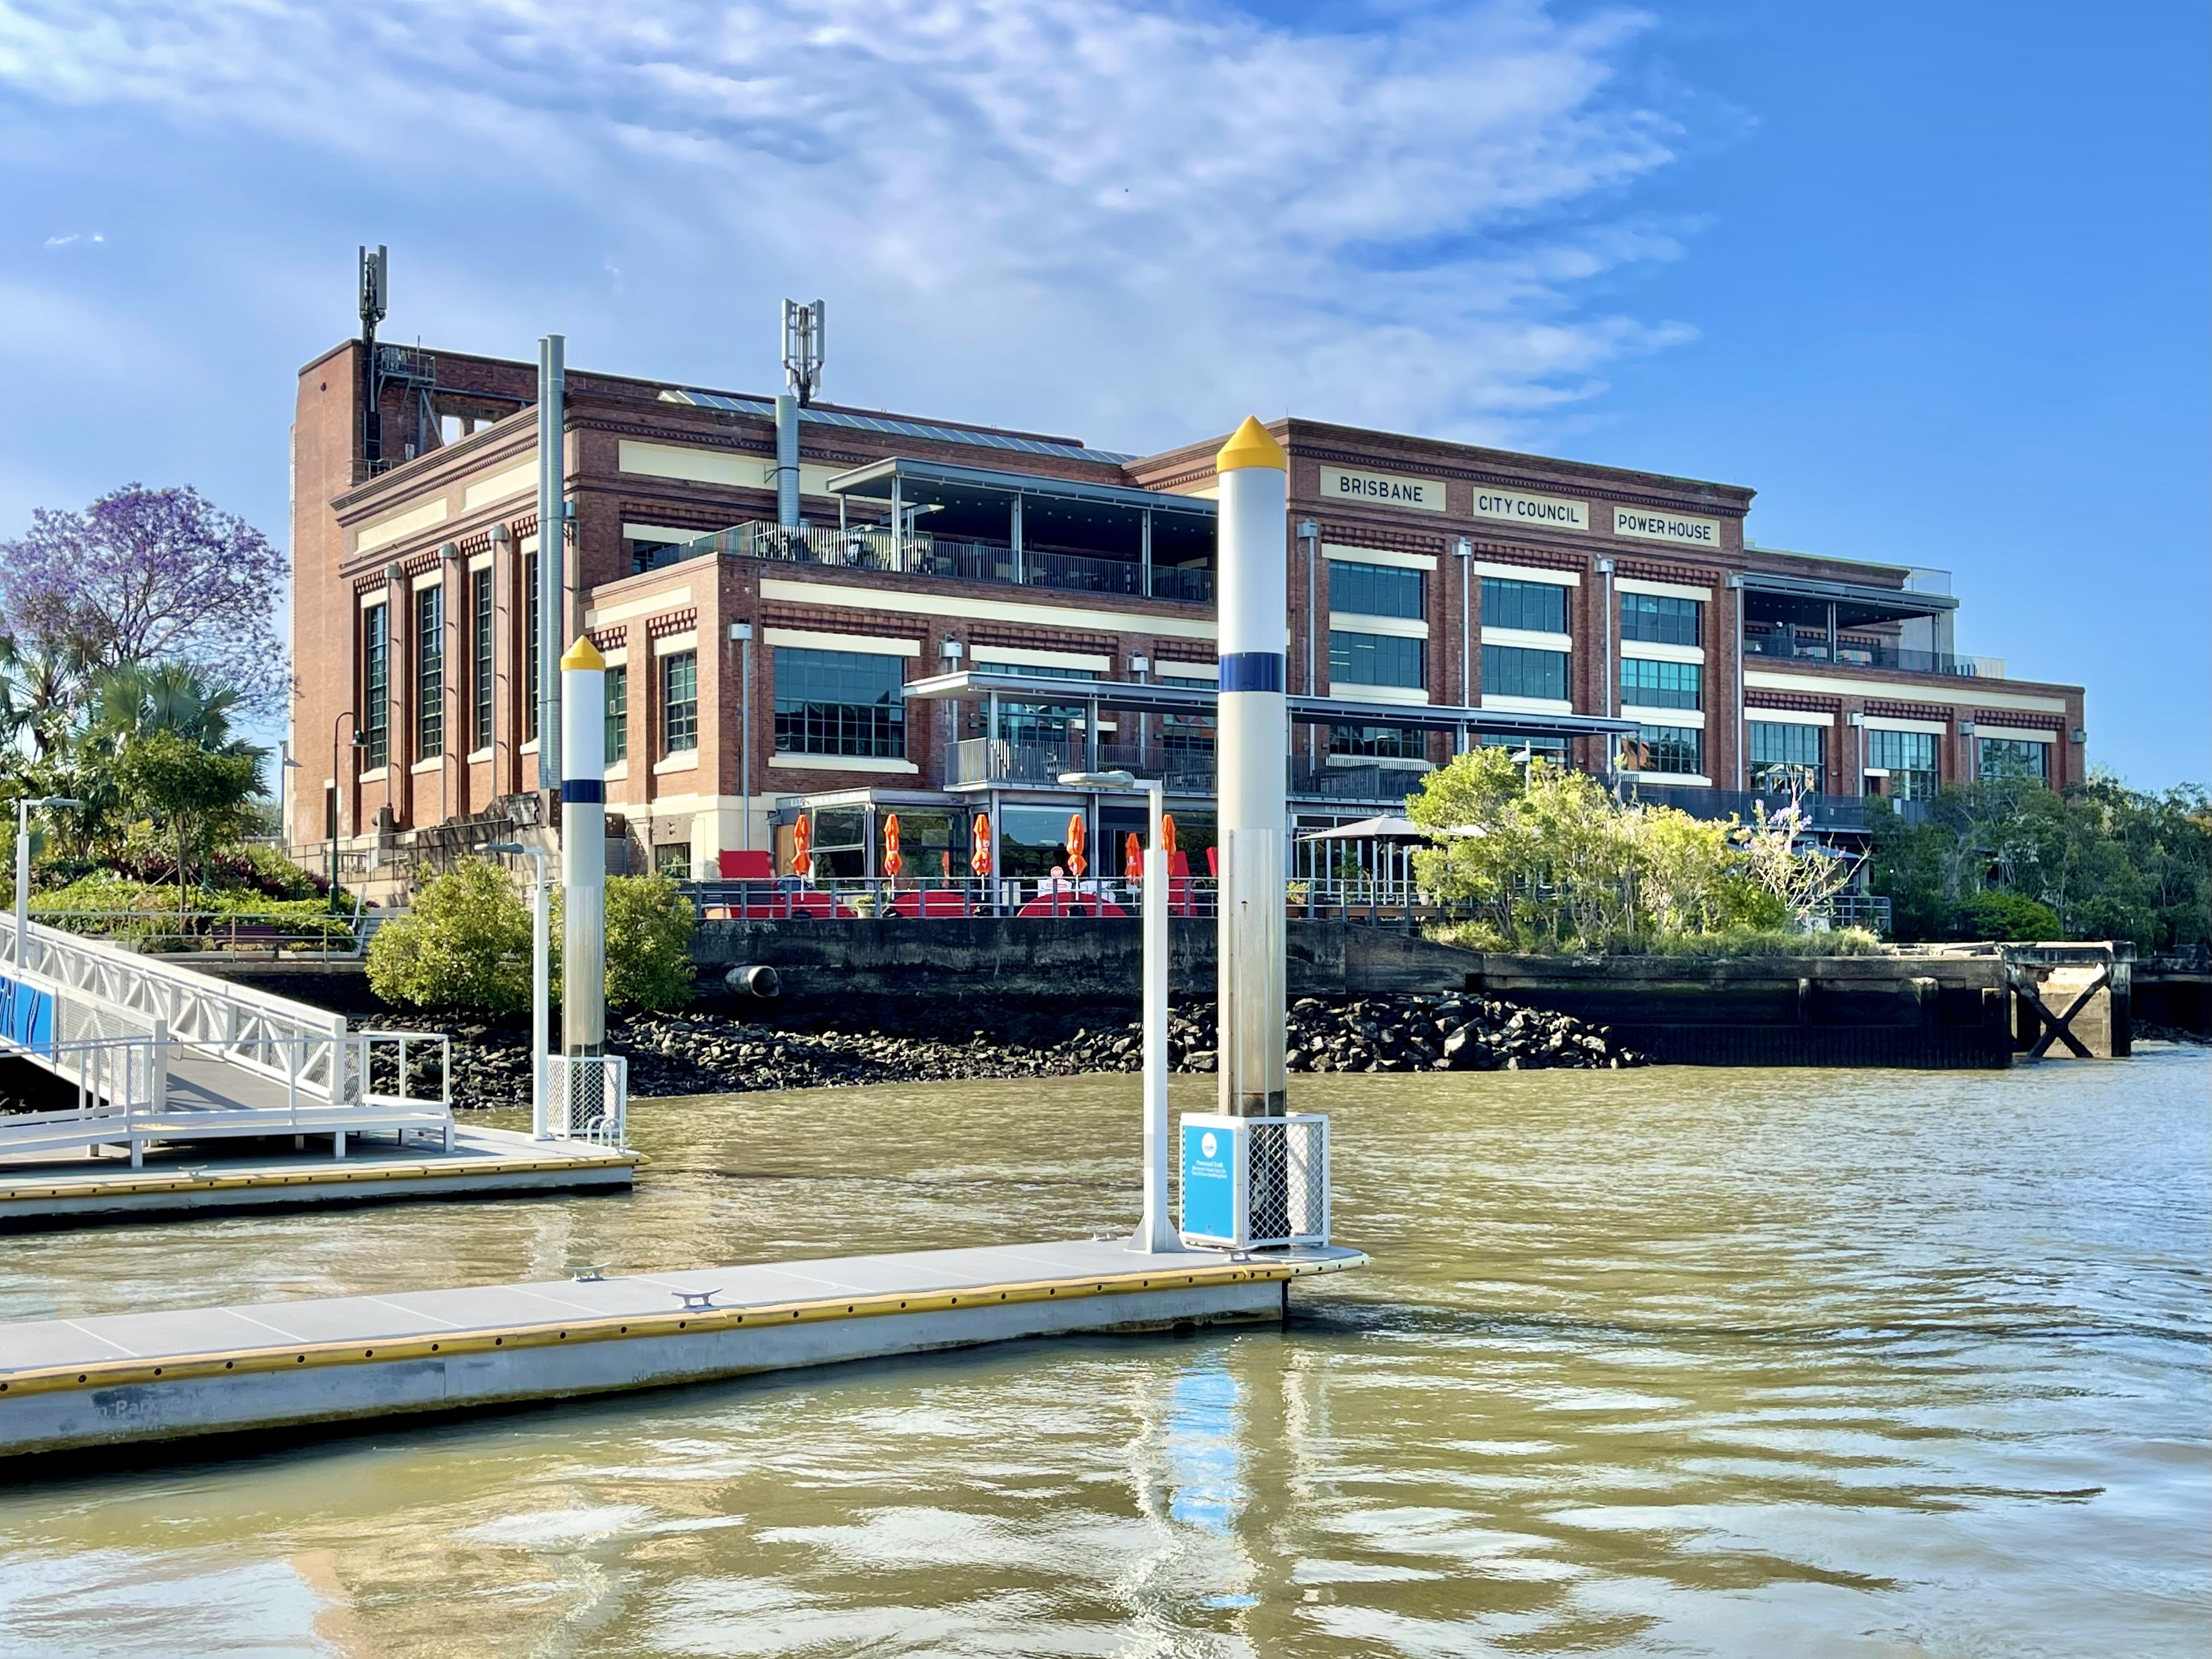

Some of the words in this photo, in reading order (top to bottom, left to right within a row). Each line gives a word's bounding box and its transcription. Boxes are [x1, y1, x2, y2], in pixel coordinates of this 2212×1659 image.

[1340, 476, 1423, 502] BRISBANE
[1479, 495, 1513, 514] CITY
[1518, 501, 1579, 523] COUNCIL
[1618, 514, 1665, 534] POWER
[1668, 521, 1711, 540] HOUSE
